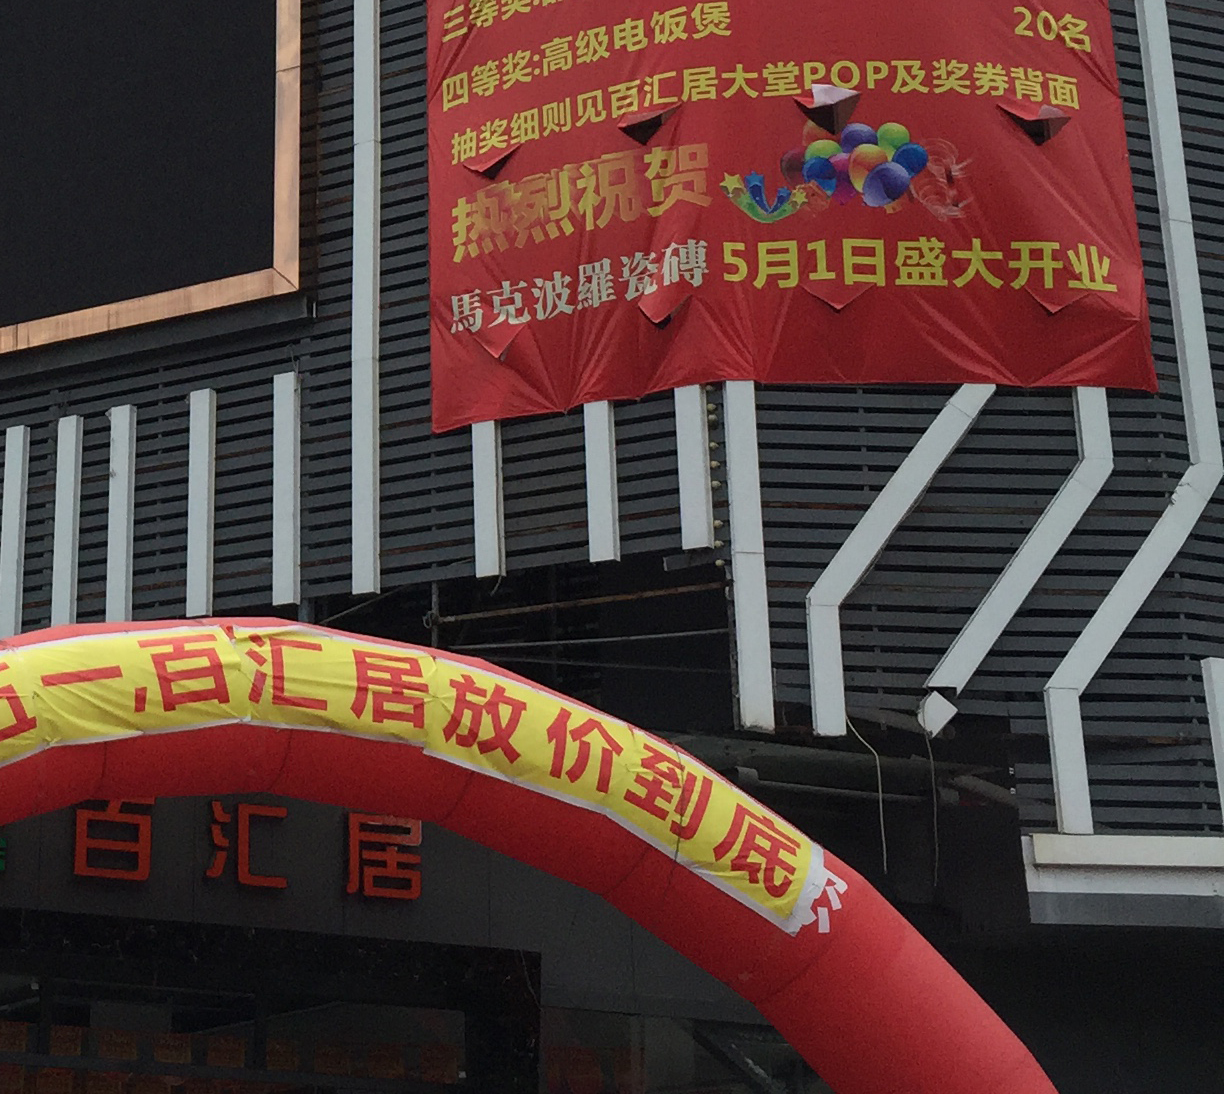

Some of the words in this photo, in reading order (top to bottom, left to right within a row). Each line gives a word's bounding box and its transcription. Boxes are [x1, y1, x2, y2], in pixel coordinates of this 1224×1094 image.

[441, 1, 733, 113] 四等奖:高级电饭煲
[1013, 6, 1093, 53] 20名
[451, 59, 1080, 166] 抽奖细则见百汇居大堂POP及奖券背面
[451, 142, 714, 263] 热烈祝贺
[721, 237, 1118, 294] 5月1日盛大开业
[73, 796, 422, 900] 百汇居
